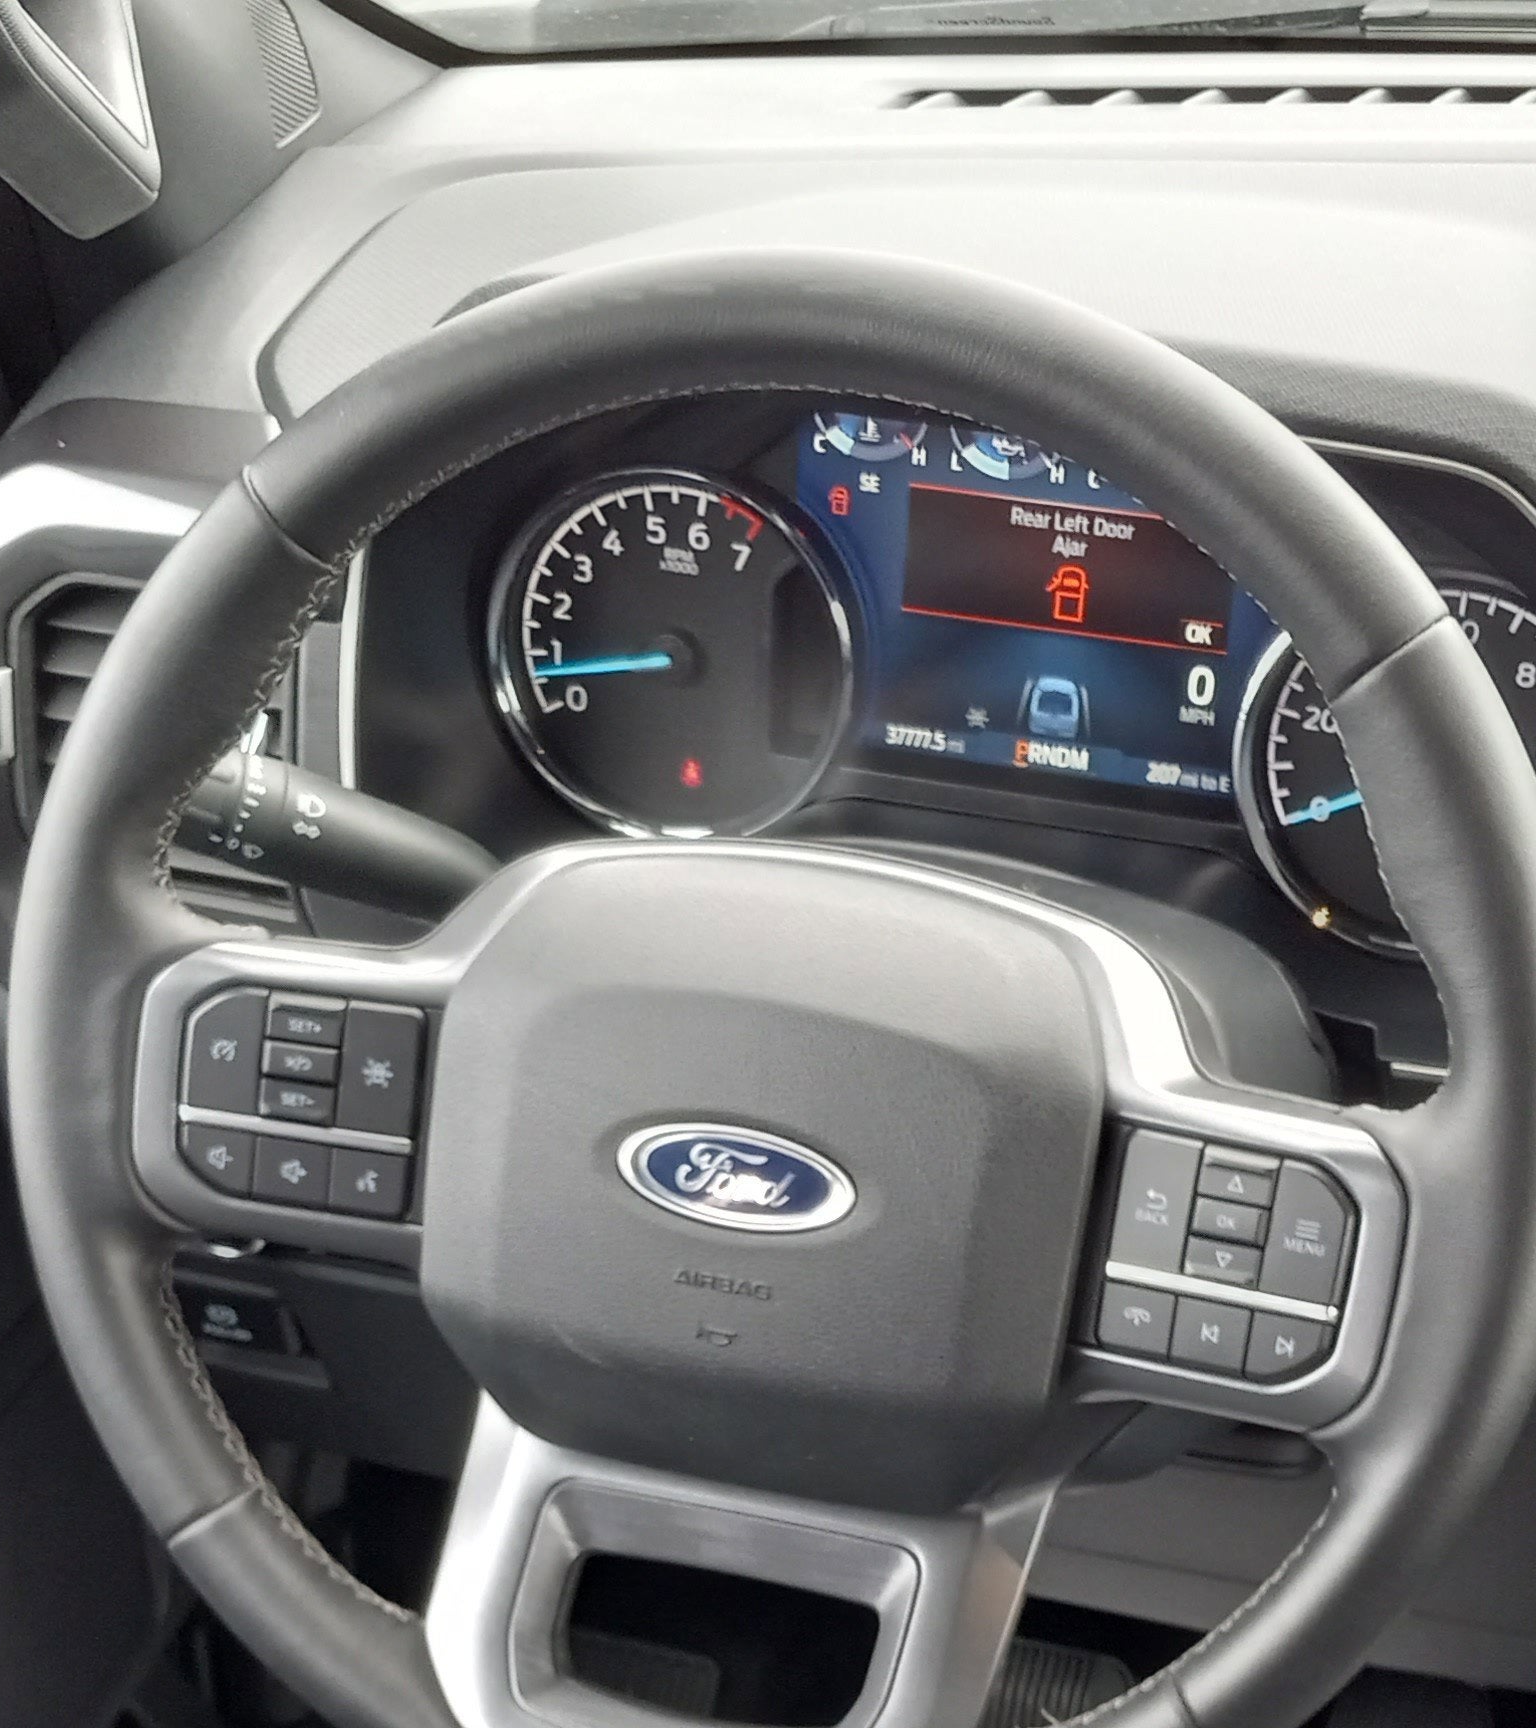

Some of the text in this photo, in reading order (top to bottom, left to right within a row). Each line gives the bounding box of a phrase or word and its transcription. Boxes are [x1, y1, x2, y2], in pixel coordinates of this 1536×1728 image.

[646, 515, 666, 544] 5
[688, 523, 710, 550] 6
[1011, 506, 1135, 540] Rear Left Door
[603, 530, 625, 555] 4
[1053, 535, 1088, 556] Ajar
[573, 553, 593, 582] 3
[731, 544, 752, 571] 7
[553, 592, 572, 620] 2
[1186, 623, 1212, 645] OK
[551, 639, 562, 664] 1
[566, 685, 587, 711] 0
[1188, 665, 1214, 706] 0
[1303, 707, 1336, 733] 20
[674, 1141, 796, 1207] Ford
[1215, 1214, 1237, 1230] OK
[1284, 1237, 1325, 1256] MENU
[674, 1270, 772, 1299] AIRBAG
